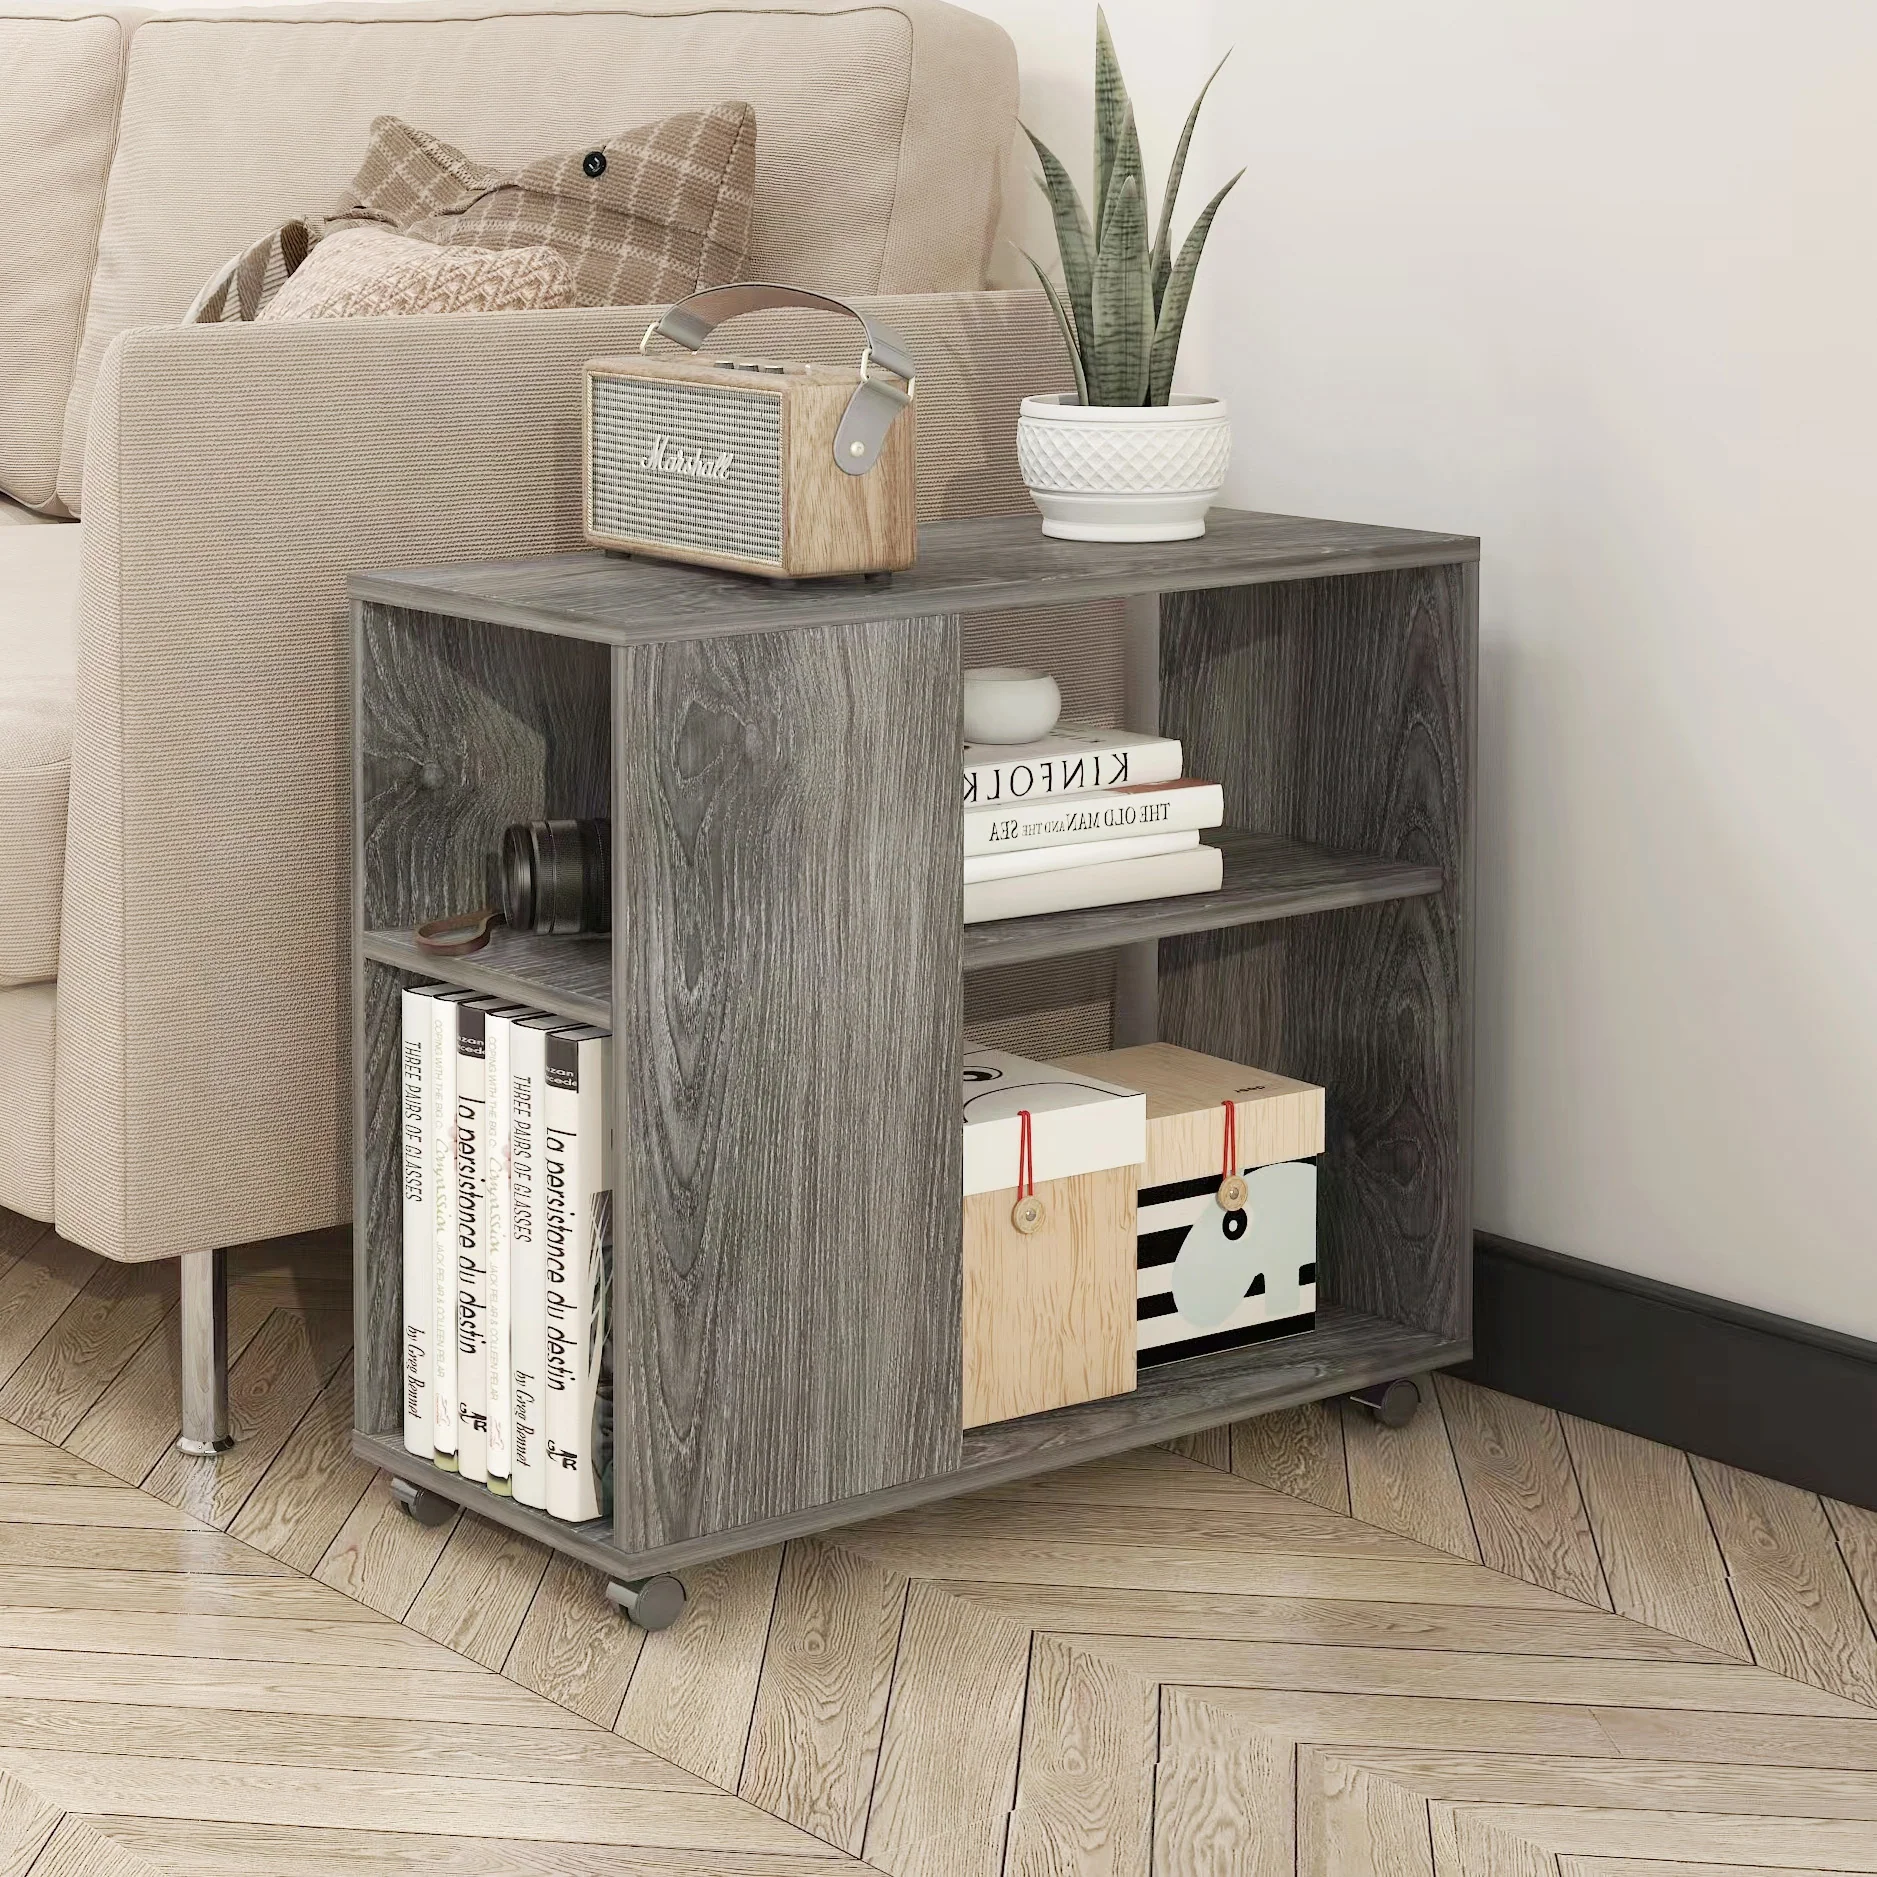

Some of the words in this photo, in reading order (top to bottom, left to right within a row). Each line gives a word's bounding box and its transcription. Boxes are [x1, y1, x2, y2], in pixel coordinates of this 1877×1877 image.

[640, 433, 735, 480] Marshall
[404, 1040, 422, 1081] THREE
[404, 1083, 422, 1121] PAIRS
[513, 1075, 531, 1118] THREE
[404, 1123, 422, 1143] OF
[514, 1119, 531, 1160] PAIRS
[404, 1145, 422, 1202] GLASSES
[456, 1124, 486, 1248] persistance
[514, 1161, 531, 1182] OF
[514, 1183, 532, 1243] GLASSES
[546, 1157, 576, 1284] persistance
[458, 1255, 486, 1285] du
[458, 1290, 486, 1354] destin
[546, 1290, 577, 1320] du
[406, 1325, 426, 1342] by
[406, 1343, 426, 1375] Greg
[514, 1370, 535, 1387] by
[546, 1325, 577, 1391] destin
[514, 1389, 535, 1421] Greg
